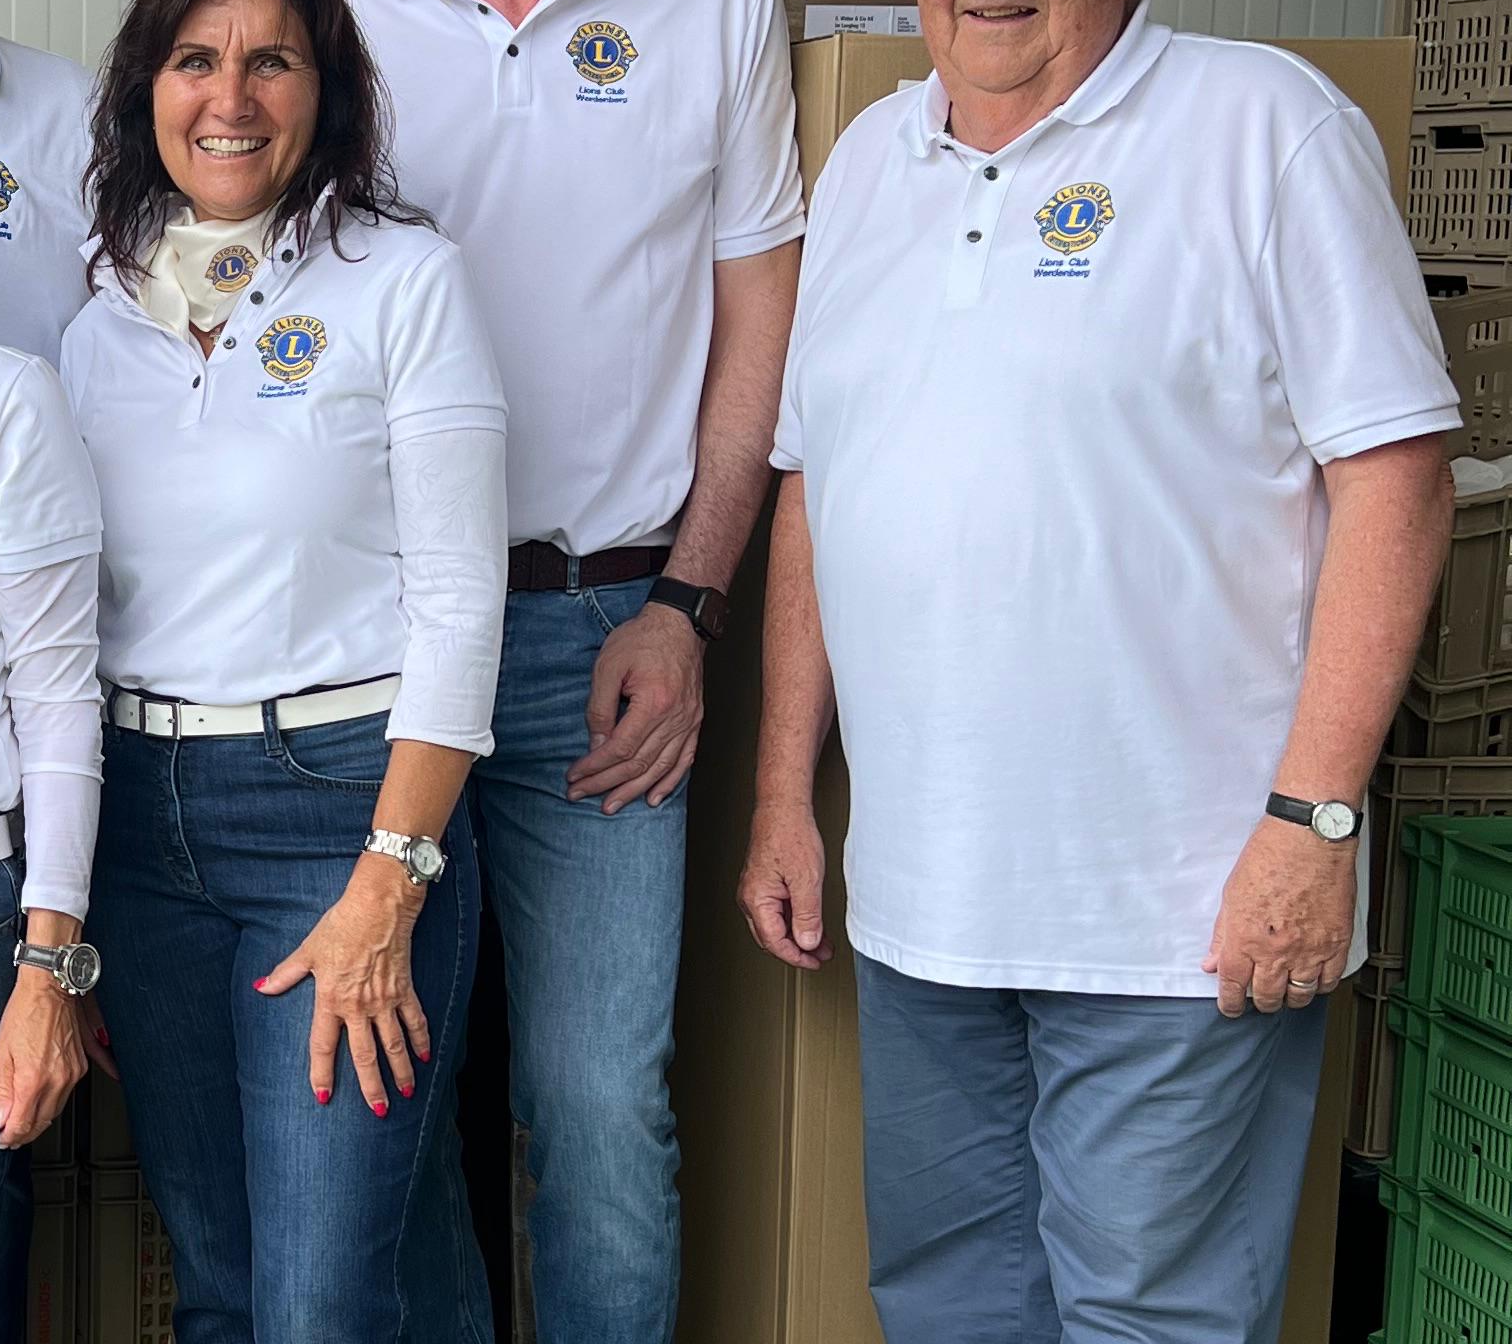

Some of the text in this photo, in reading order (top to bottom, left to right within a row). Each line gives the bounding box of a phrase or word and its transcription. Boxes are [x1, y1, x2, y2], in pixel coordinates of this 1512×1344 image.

[581, 23, 624, 38] LIONS
[593, 41, 612, 63] L
[579, 86, 625, 95] Lions Club
[1060, 185, 1106, 200] LIONS
[1065, 203, 1087, 228] L
[224, 259, 240, 277] L
[1039, 257, 1090, 267] Lions Club
[278, 317, 320, 331] LIONS
[285, 335, 304, 358] L
